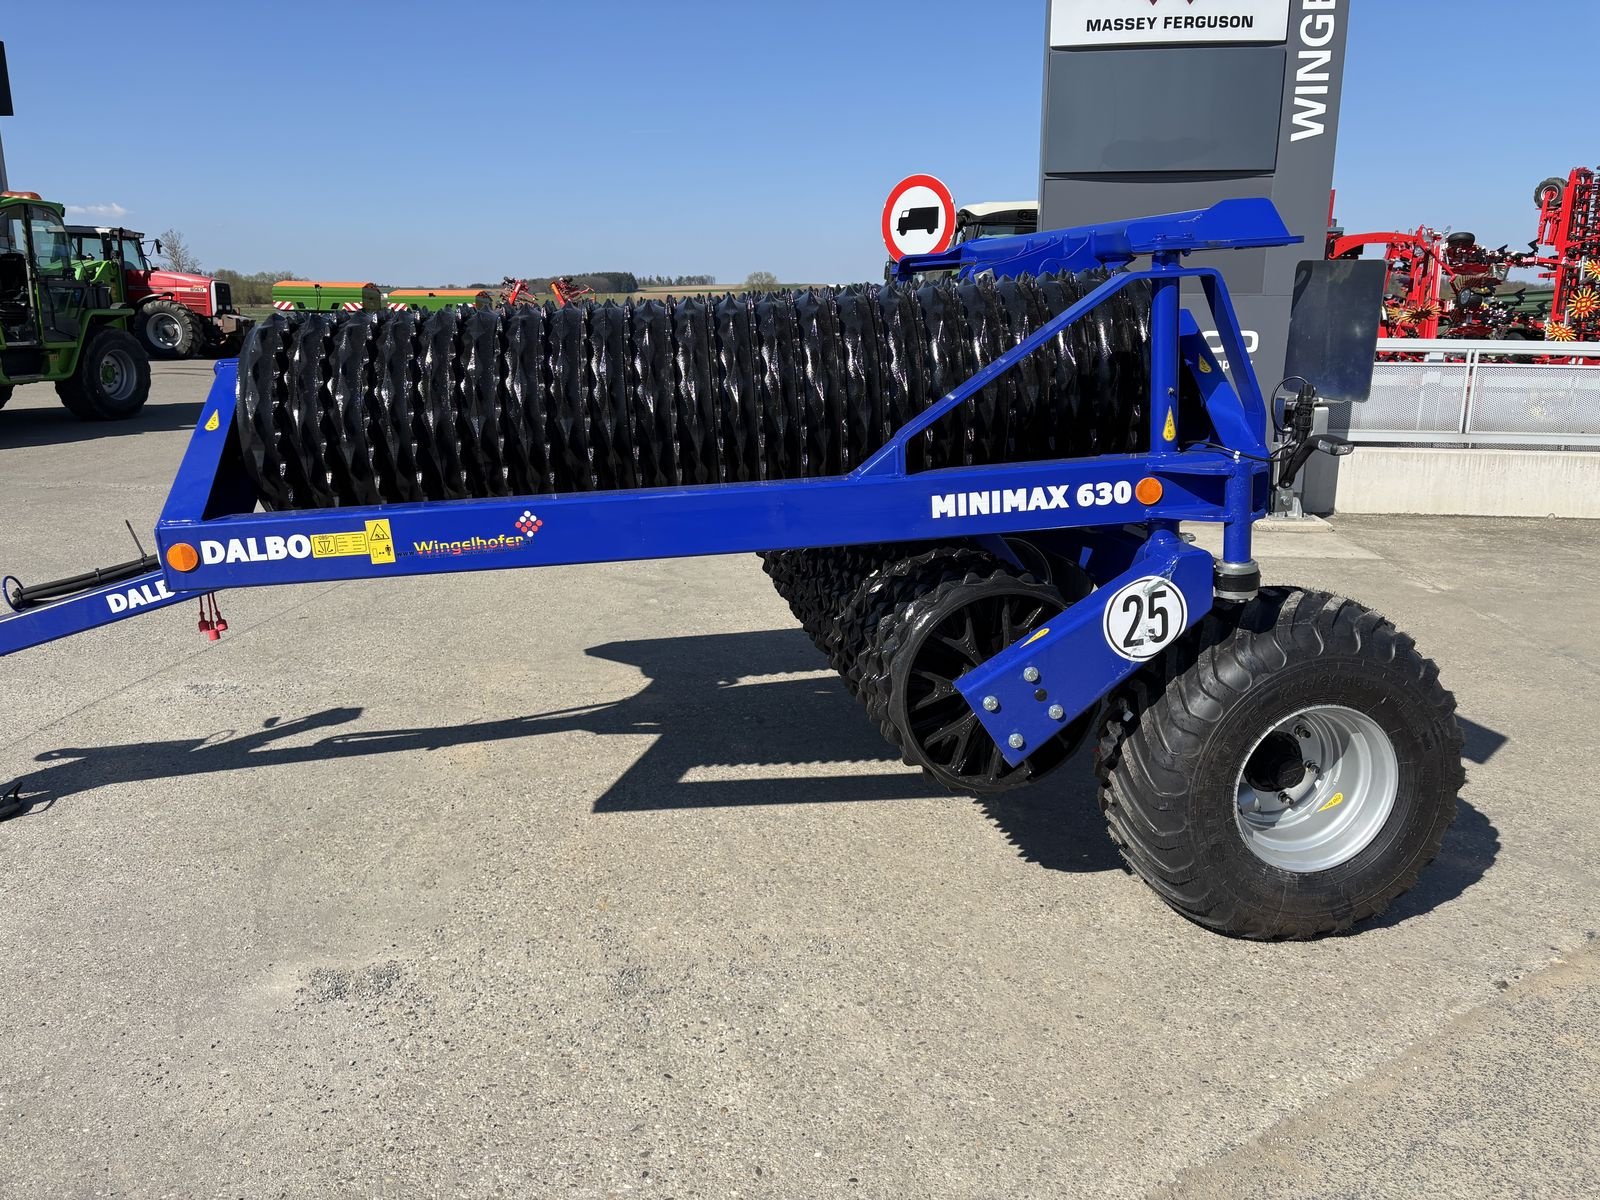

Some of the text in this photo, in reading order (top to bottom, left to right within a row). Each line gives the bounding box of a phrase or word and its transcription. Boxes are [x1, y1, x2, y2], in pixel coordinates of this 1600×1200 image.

[1086, 15, 1254, 32] MASSEY FERGUSON
[931, 480, 1132, 519] MINIMAX 630
[200, 534, 312, 565] DALBO
[1122, 589, 1169, 648] 25
